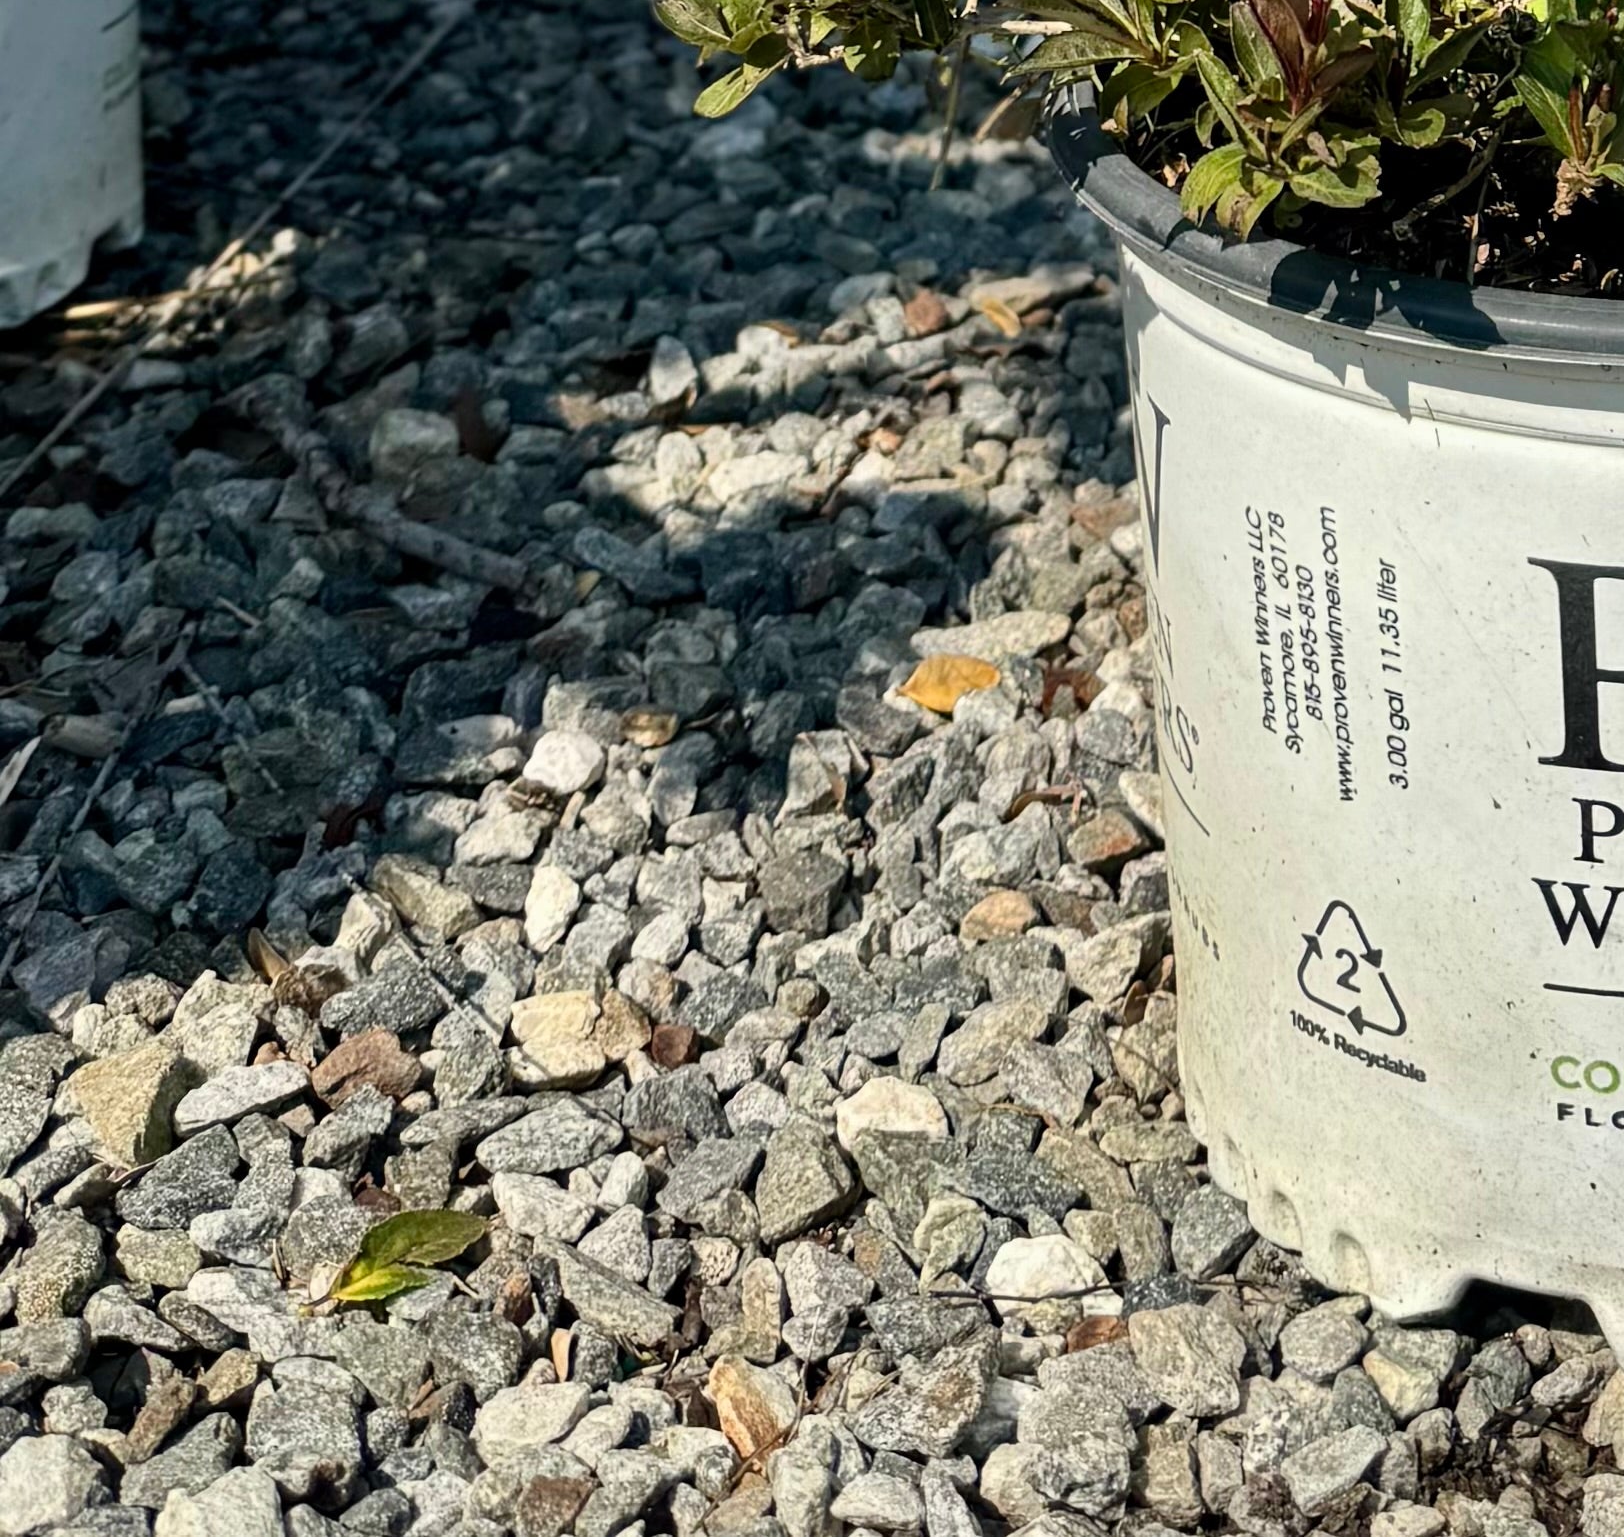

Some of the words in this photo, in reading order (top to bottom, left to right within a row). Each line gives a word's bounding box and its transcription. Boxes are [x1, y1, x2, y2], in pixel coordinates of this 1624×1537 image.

[1245, 505, 1264, 553] LLC
[1267, 510, 1290, 591] 60178
[1252, 556, 1271, 647] Winners
[1274, 603, 1292, 622] IL
[1376, 558, 1398, 603] liter
[1295, 564, 1323, 721] 815-895-8130
[1319, 506, 1358, 802] www.provenwinners.com
[1379, 606, 1403, 674] 11.35
[1260, 651, 1278, 734] Proven
[1280, 628, 1304, 755] Sycamore,
[1383, 688, 1410, 732] gal
[1387, 734, 1409, 789] 3.00
[1335, 948, 1361, 994] 2
[1290, 1009, 1330, 1046] 100%
[1333, 1032, 1428, 1083] Recyclable
